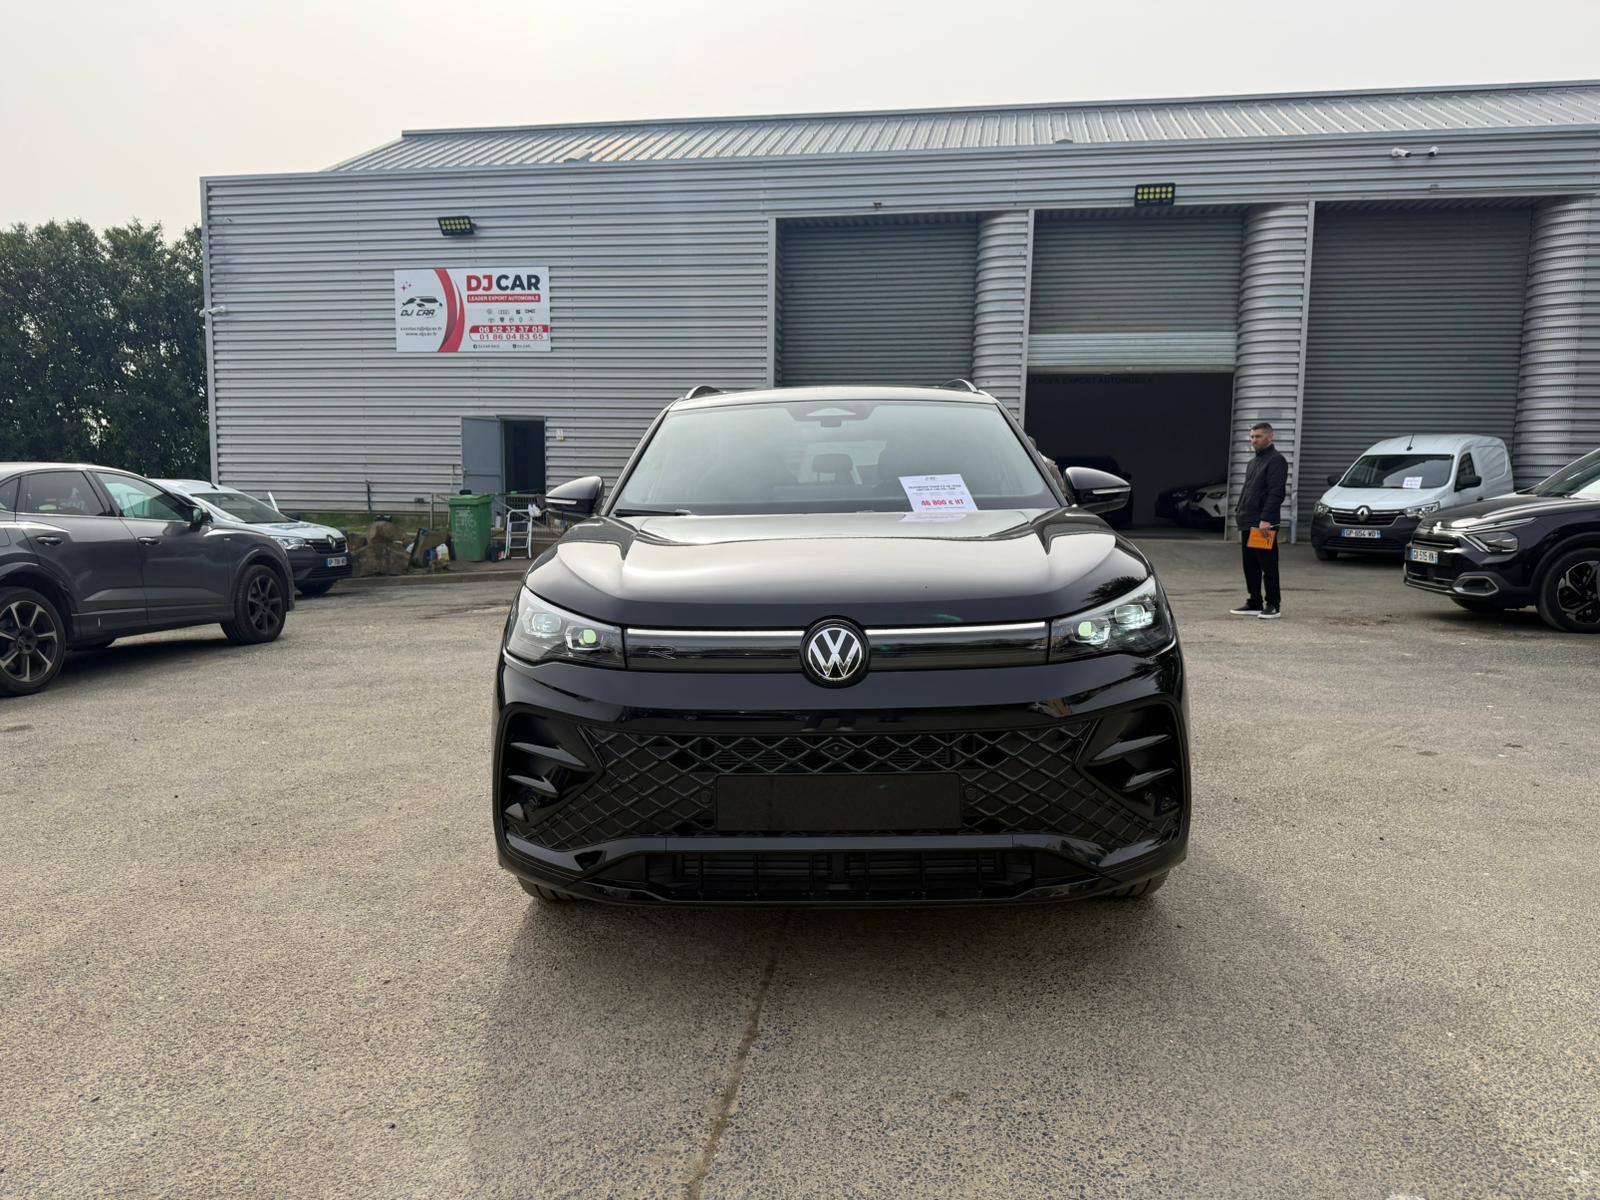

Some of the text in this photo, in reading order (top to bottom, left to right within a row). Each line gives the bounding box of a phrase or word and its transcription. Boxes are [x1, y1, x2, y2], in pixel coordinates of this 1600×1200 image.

[466, 274, 541, 292] DJ CAR
[400, 309, 436, 317] DJ CAR
